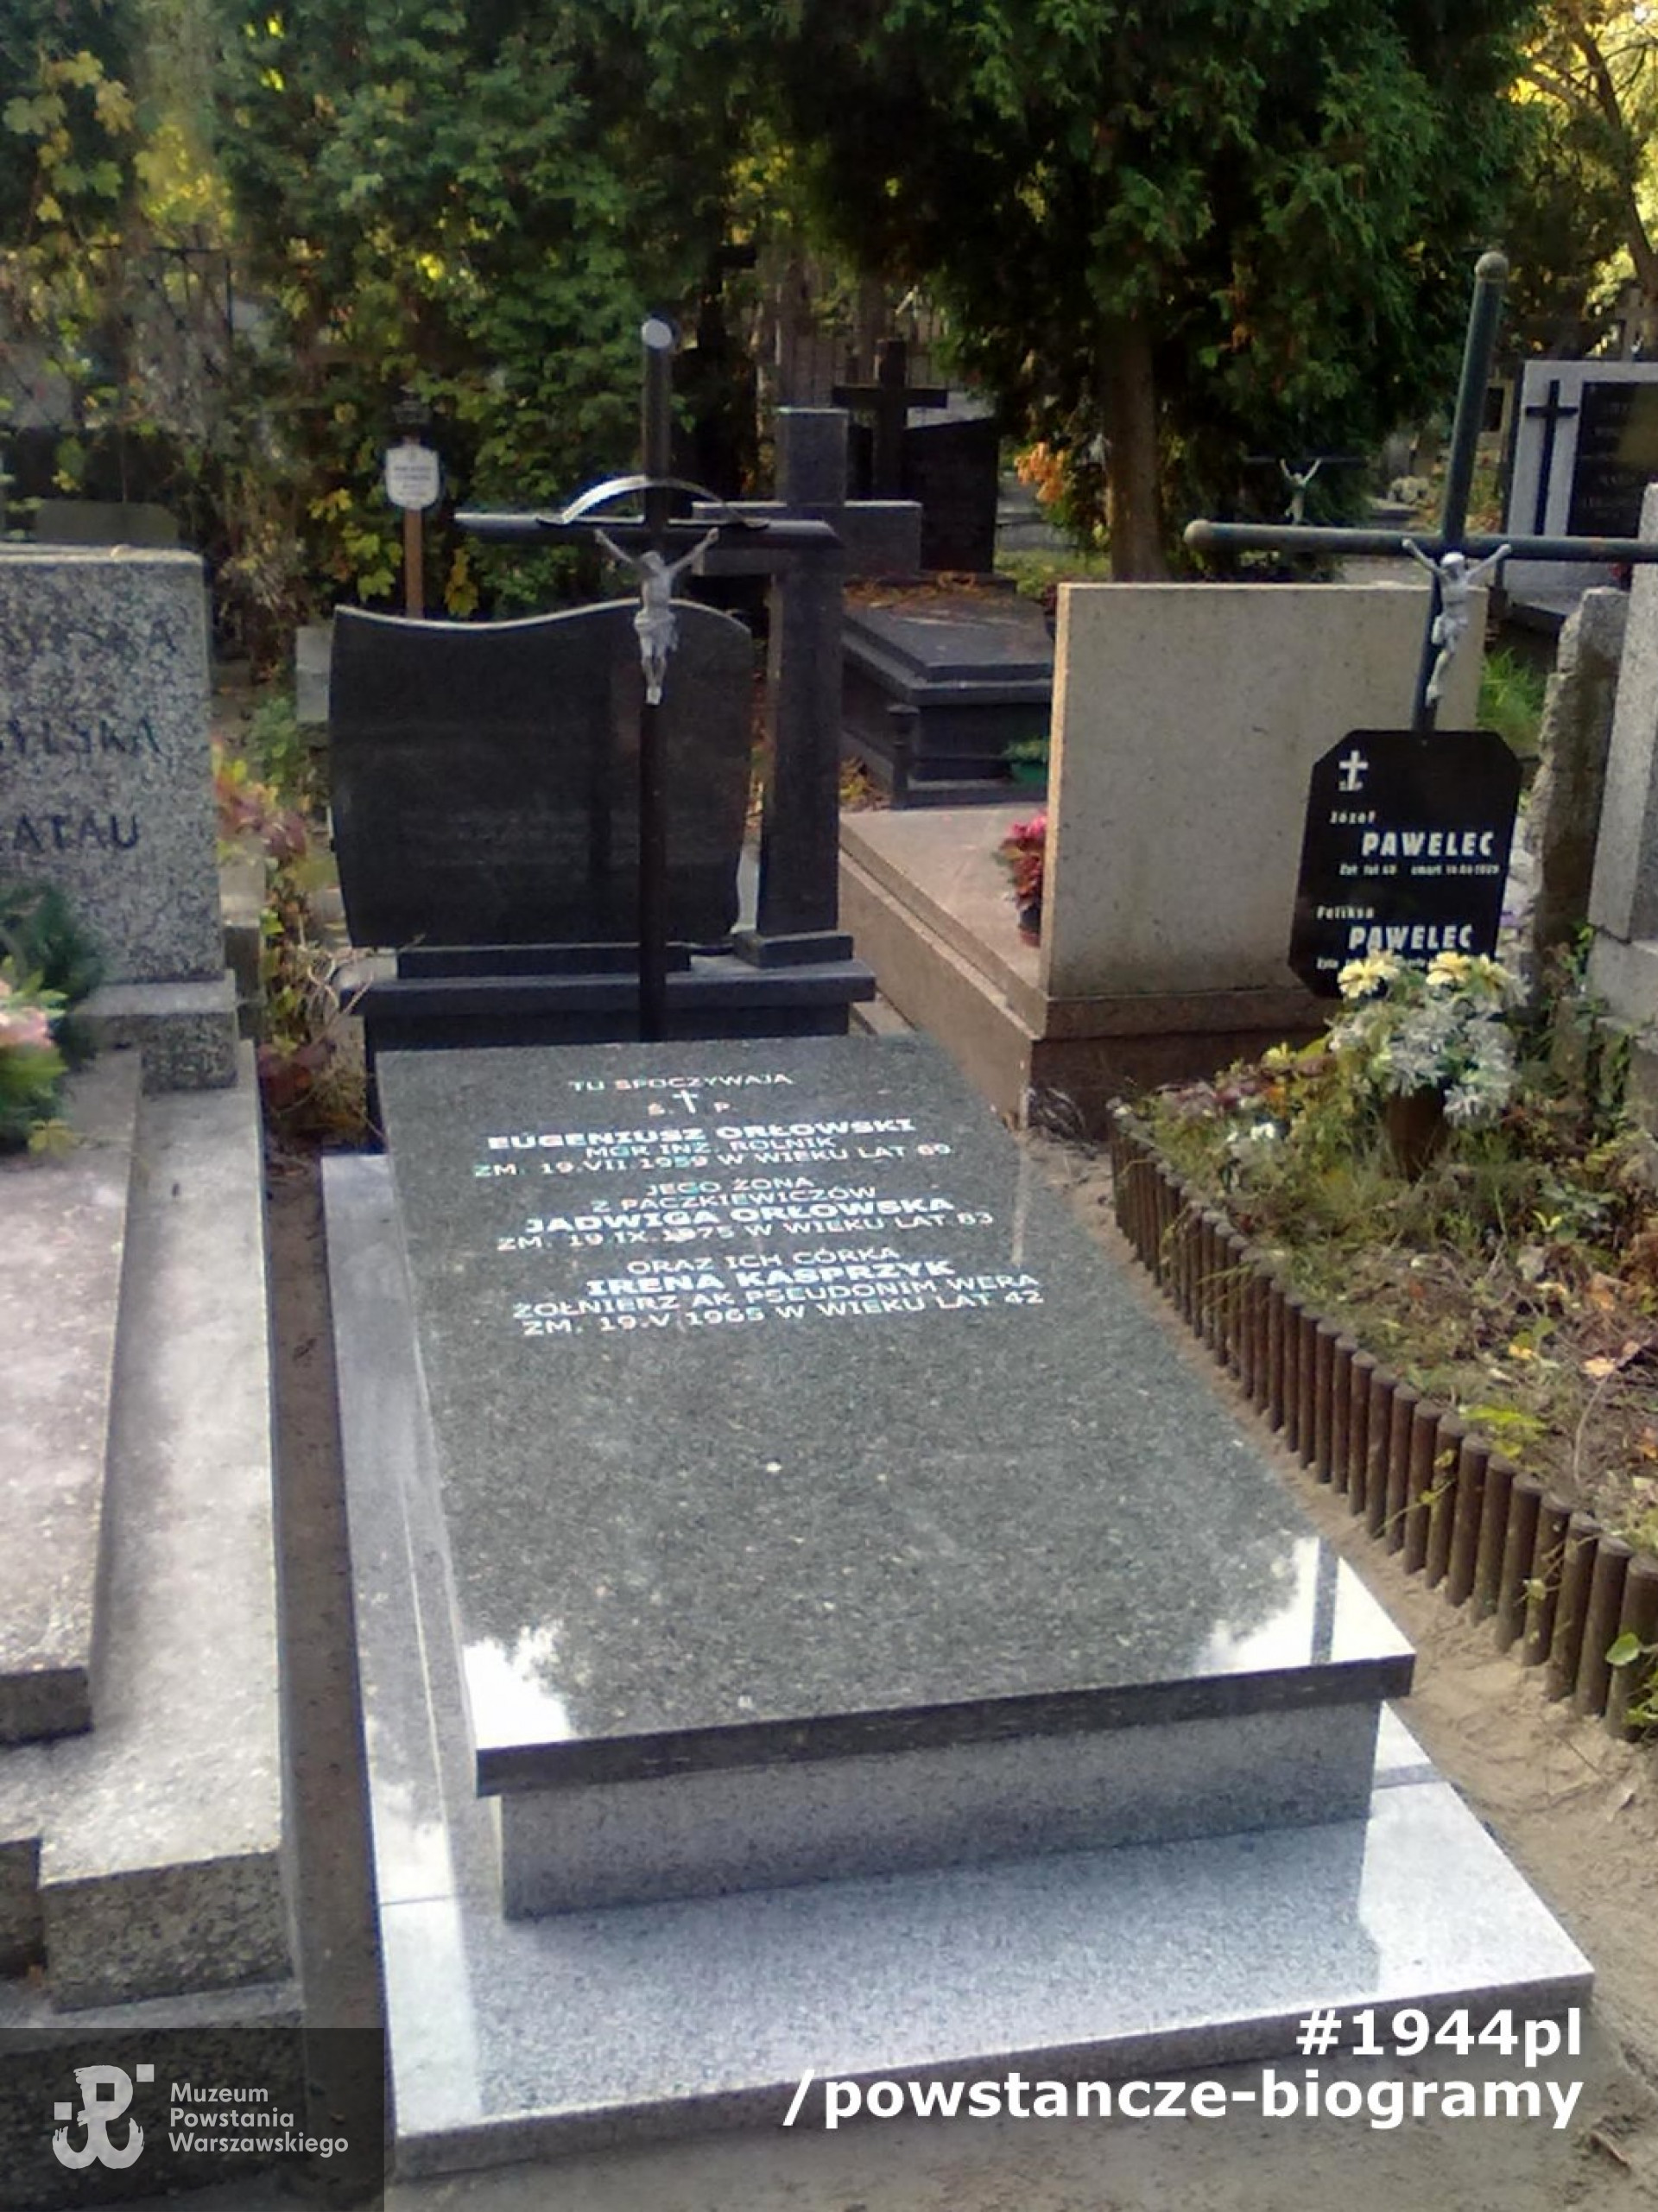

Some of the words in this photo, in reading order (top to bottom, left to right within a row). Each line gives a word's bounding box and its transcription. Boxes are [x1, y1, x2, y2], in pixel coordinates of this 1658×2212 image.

[1362, 831, 1495, 857] PAWELEC
[1349, 925, 1473, 953] PAWELEC
[569, 1080, 604, 1092] TU
[488, 1128, 706, 1150] EUGENIUSZ
[716, 1119, 916, 1140] ORŁOWSKI
[585, 1144, 649, 1159] MGR
[731, 1138, 836, 1151] ROLNIK
[718, 1155, 744, 1165] W
[755, 1149, 848, 1163] WIEKU
[857, 1144, 907, 1158] LAT
[917, 1144, 952, 1157] 69
[647, 1181, 721, 1195] JEGO
[525, 1210, 721, 1233] JADWIGA
[731, 1198, 954, 1222] ORŁOWSKA
[590, 1200, 611, 1213] Z
[497, 1237, 553, 1251] ZM.
[744, 1224, 773, 1237] W
[783, 1217, 884, 1234] WIEKU
[895, 1214, 946, 1229] LAT
[627, 1257, 714, 1274] ORAZ
[725, 1254, 782, 1269] ICH
[793, 1246, 901, 1264] CÓRKA
[586, 1273, 725, 1296] IRENA
[736, 1260, 956, 1288] KASPRZYK
[692, 1291, 735, 1307] AK
[746, 1279, 937, 1304] PSEUDONIM
[946, 1273, 1039, 1291] WERA
[522, 1318, 585, 1335] ZM.
[775, 1305, 805, 1319] W
[817, 1296, 926, 1317] WIEKU
[936, 1293, 992, 1309] LAT
[1004, 1290, 1044, 1304] 42
